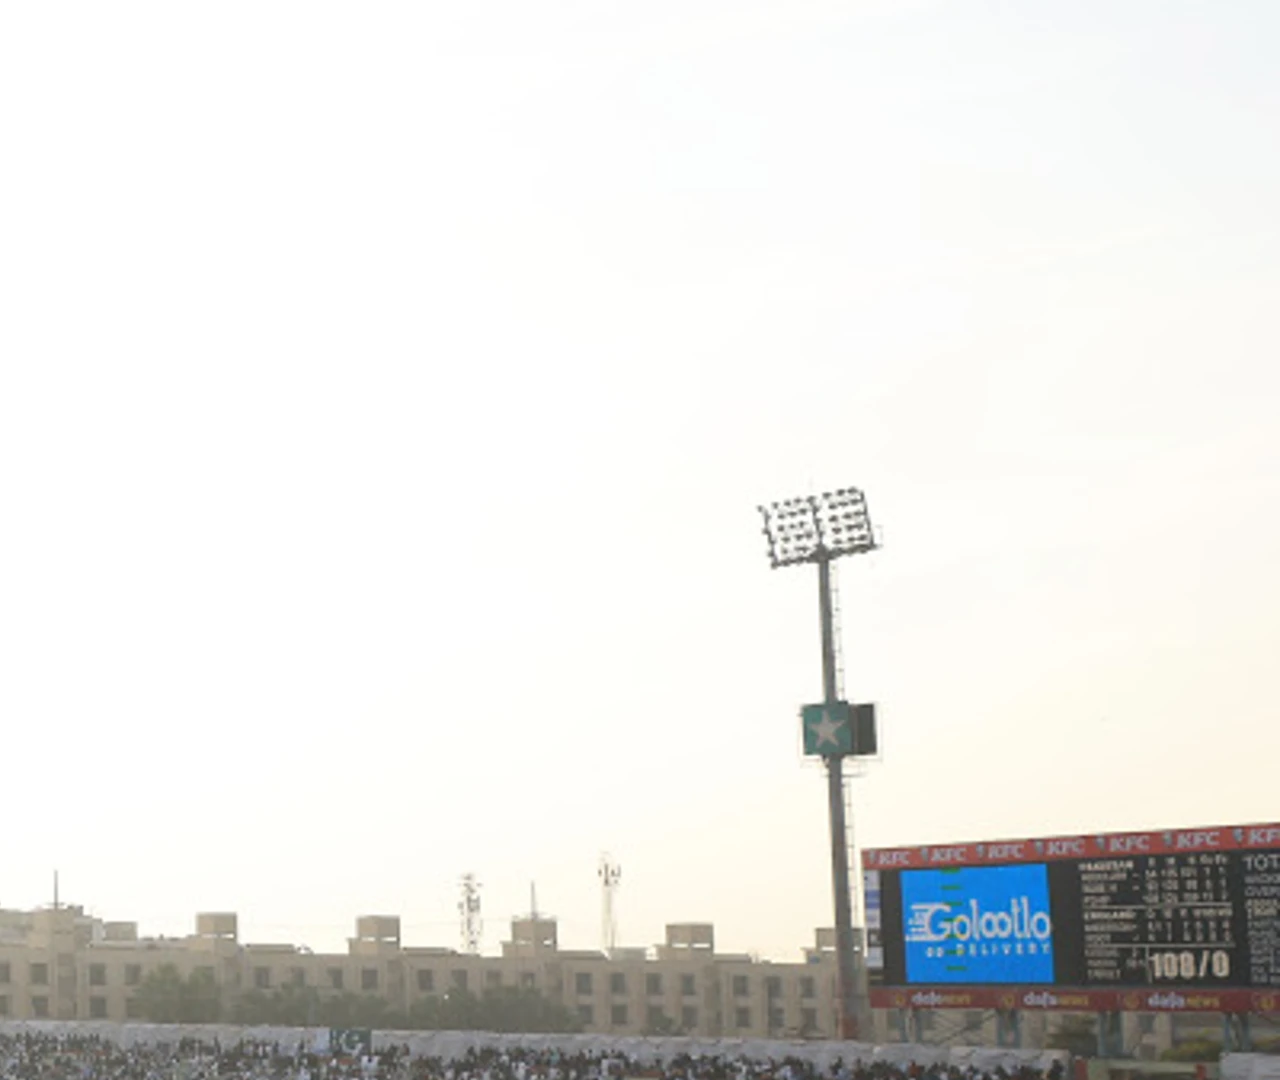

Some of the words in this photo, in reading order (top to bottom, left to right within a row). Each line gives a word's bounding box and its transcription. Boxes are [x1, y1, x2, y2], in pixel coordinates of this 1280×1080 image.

[1109, 836, 1151, 851] KFC
[1177, 832, 1220, 848] KFC
[1248, 828, 1280, 844] KF
[988, 844, 1024, 858] KFC
[1047, 840, 1085, 854] KFC
